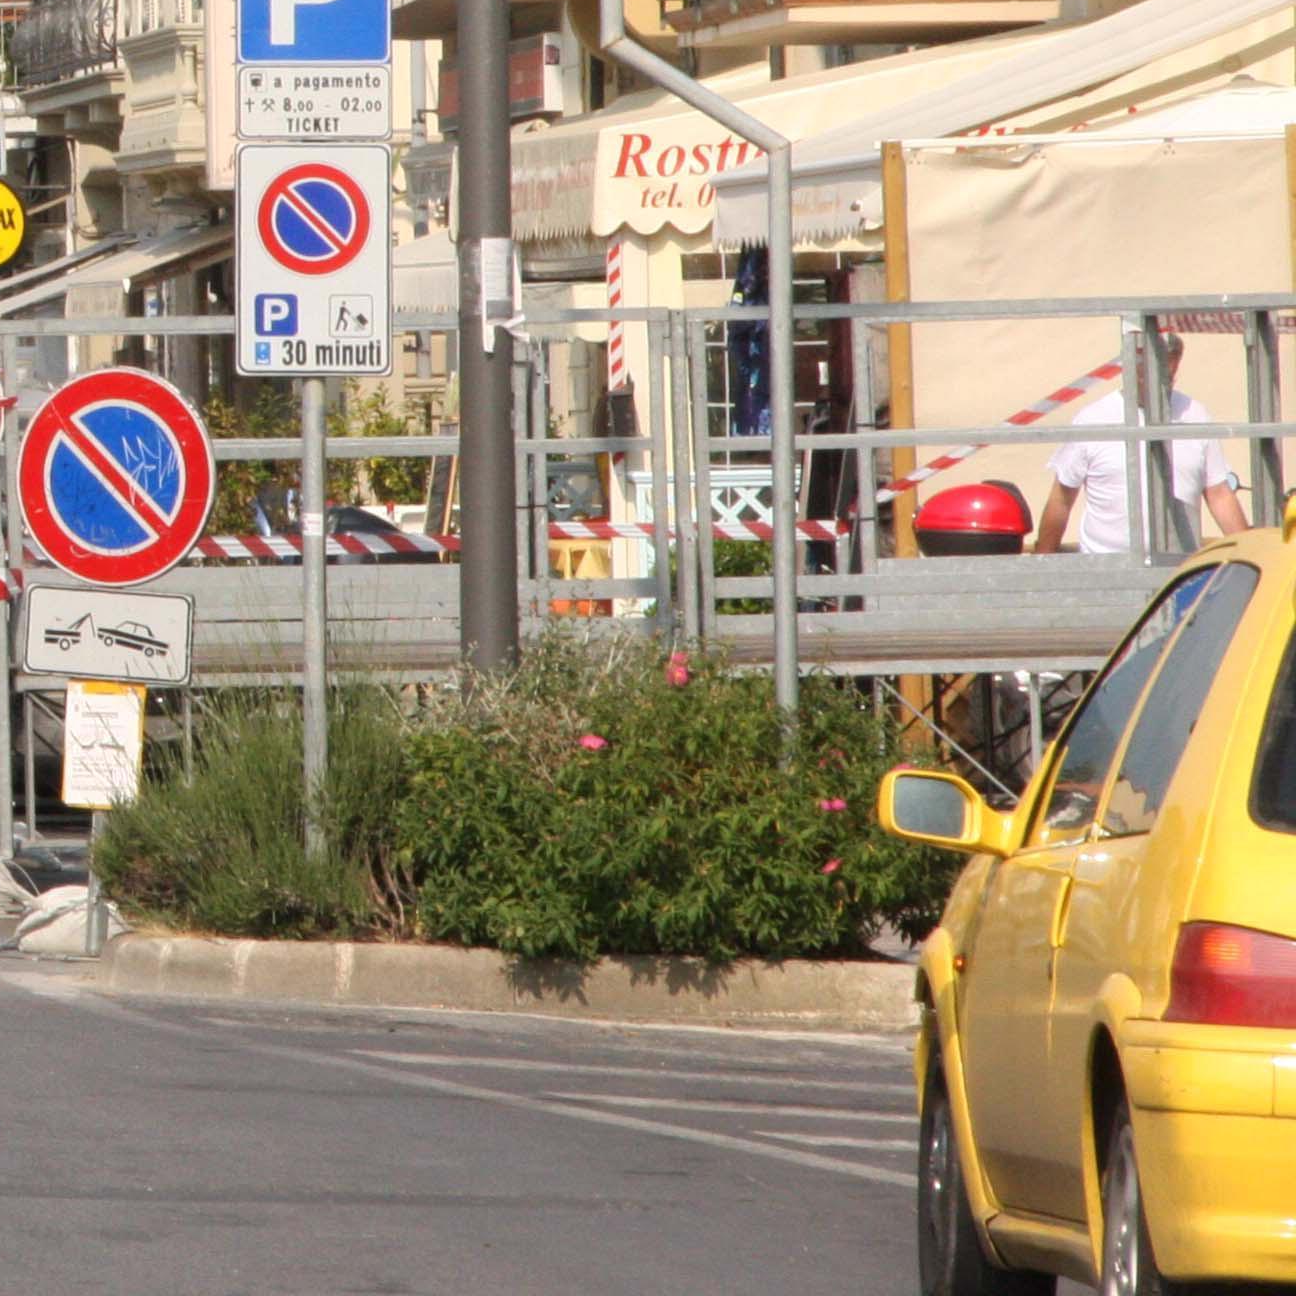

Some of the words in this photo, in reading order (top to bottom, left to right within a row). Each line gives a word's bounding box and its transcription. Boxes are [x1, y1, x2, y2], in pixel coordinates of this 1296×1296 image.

[274, 77, 282, 88] a
[294, 73, 381, 91] pagamento
[287, 117, 340, 132] TICKET
[640, 183, 683, 209] tel.
[263, 298, 290, 332] P
[282, 340, 307, 366] 30
[315, 339, 381, 366] minuti
